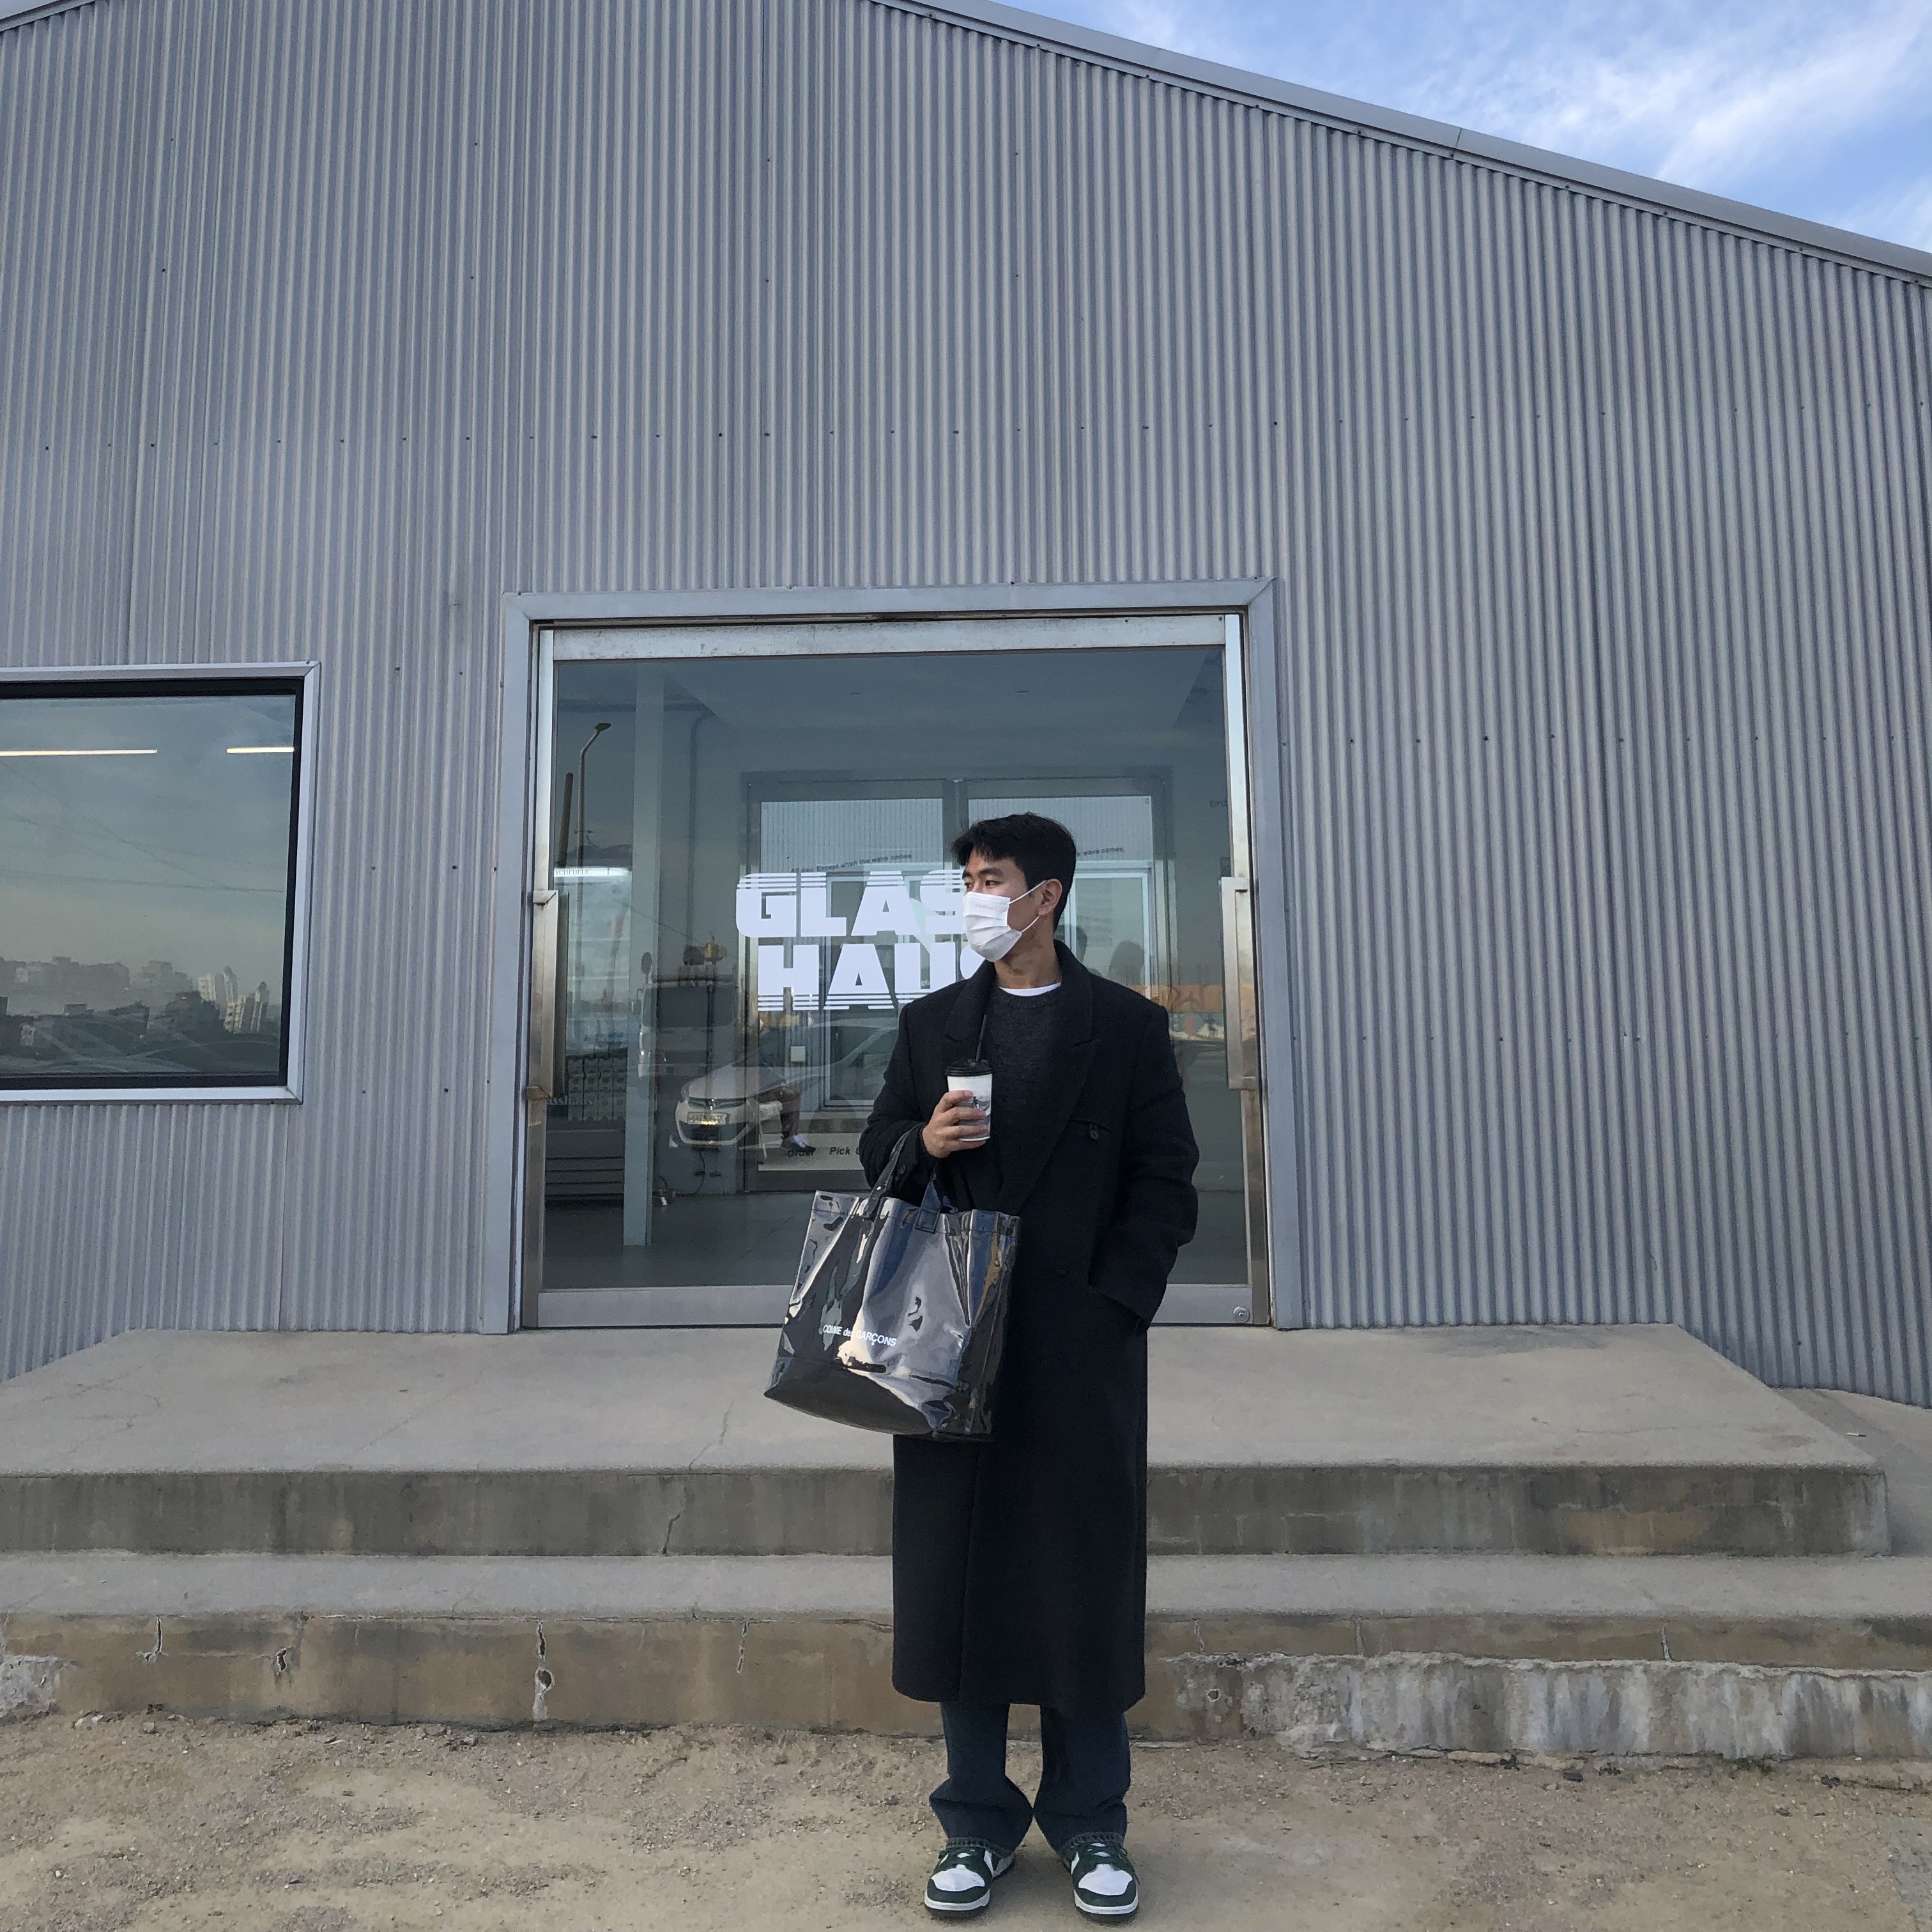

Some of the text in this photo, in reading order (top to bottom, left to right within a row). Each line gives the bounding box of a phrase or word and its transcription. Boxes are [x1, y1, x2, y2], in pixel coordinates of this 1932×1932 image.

[736, 870, 967, 938] GLAS
[758, 942, 986, 1011] HAU
[829, 1146, 851, 1156] Pick
[822, 1324, 843, 1335] COMME
[855, 1329, 897, 1347] GARÇONS
